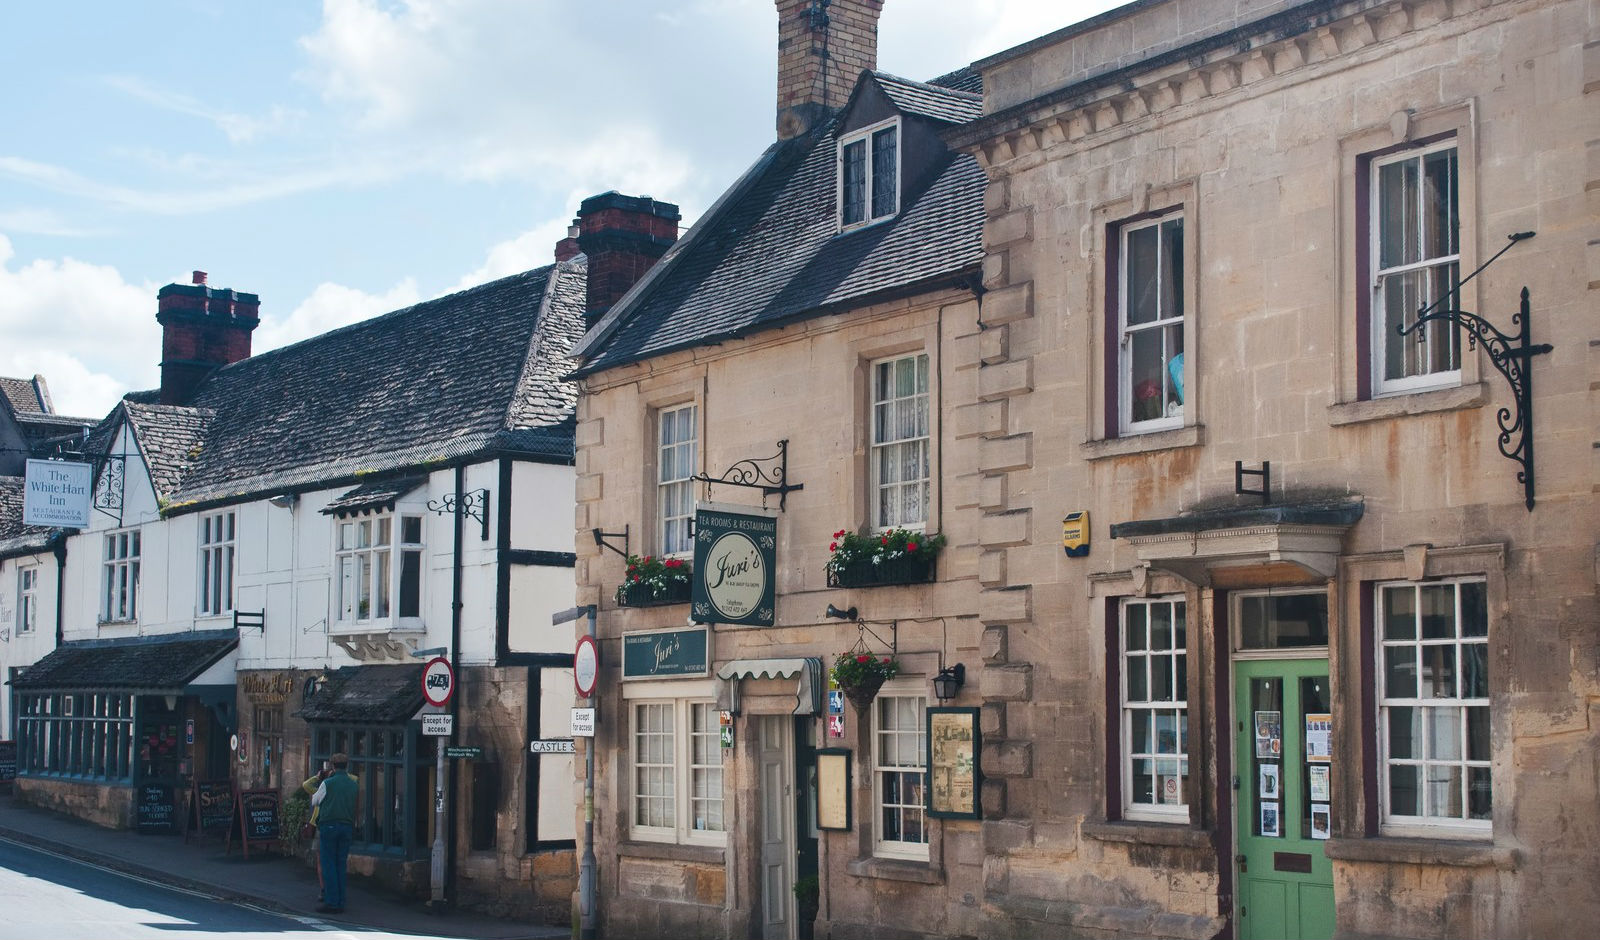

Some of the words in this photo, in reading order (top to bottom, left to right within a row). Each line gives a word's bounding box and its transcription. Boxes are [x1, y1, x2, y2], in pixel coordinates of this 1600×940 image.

[48, 470, 69, 480] The
[31, 481, 59, 493] White
[62, 484, 84, 495] Hart
[49, 495, 65, 505] Inn
[32, 507, 75, 515] RESTAURANT
[699, 516, 709, 526] TEA
[711, 518, 732, 528] ROOMS
[733, 520, 738, 528] &
[739, 520, 774, 532] RESTAURANT
[709, 550, 760, 589] Juri's
[650, 633, 680, 673] Juri's
[423, 717, 442, 725] Except
[576, 712, 590, 721] Except
[532, 742, 567, 751] CASTLE
